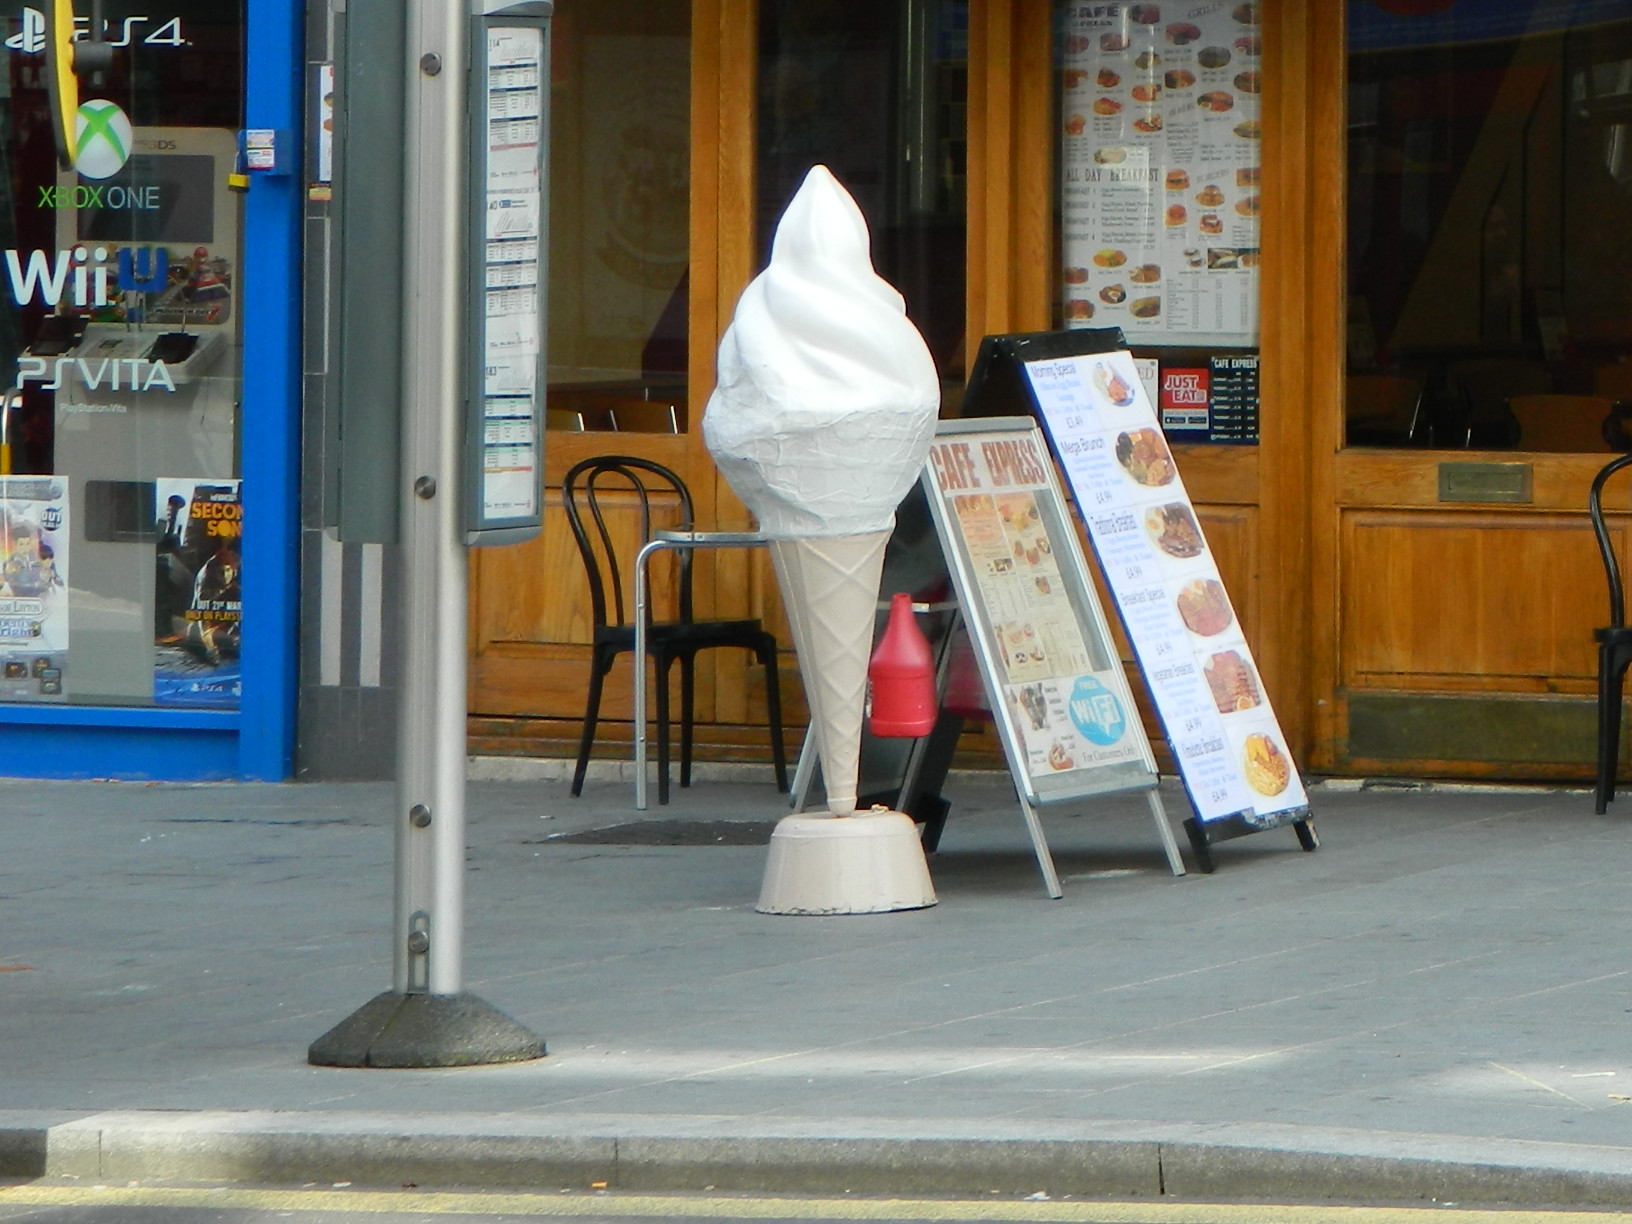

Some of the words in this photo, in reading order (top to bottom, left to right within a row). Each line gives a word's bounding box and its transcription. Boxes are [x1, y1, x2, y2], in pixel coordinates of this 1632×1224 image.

[1085, 168, 1102, 182] DAY
[38, 186, 104, 209] XBOX
[107, 186, 160, 209] ONE
[5, 247, 109, 307] Wii
[118, 247, 169, 292] U
[1054, 363, 1077, 380] Special
[1213, 358, 1229, 369] CAFE
[1231, 358, 1258, 369] EXPRESS
[1165, 375, 1199, 390] JUST
[1173, 389, 1199, 403] EAT
[1060, 439, 1081, 456] Mega
[1080, 436, 1106, 453] Brunch
[929, 442, 982, 491] CAFE
[980, 438, 1047, 487] EXPRESS
[1079, 681, 1098, 691] FREE
